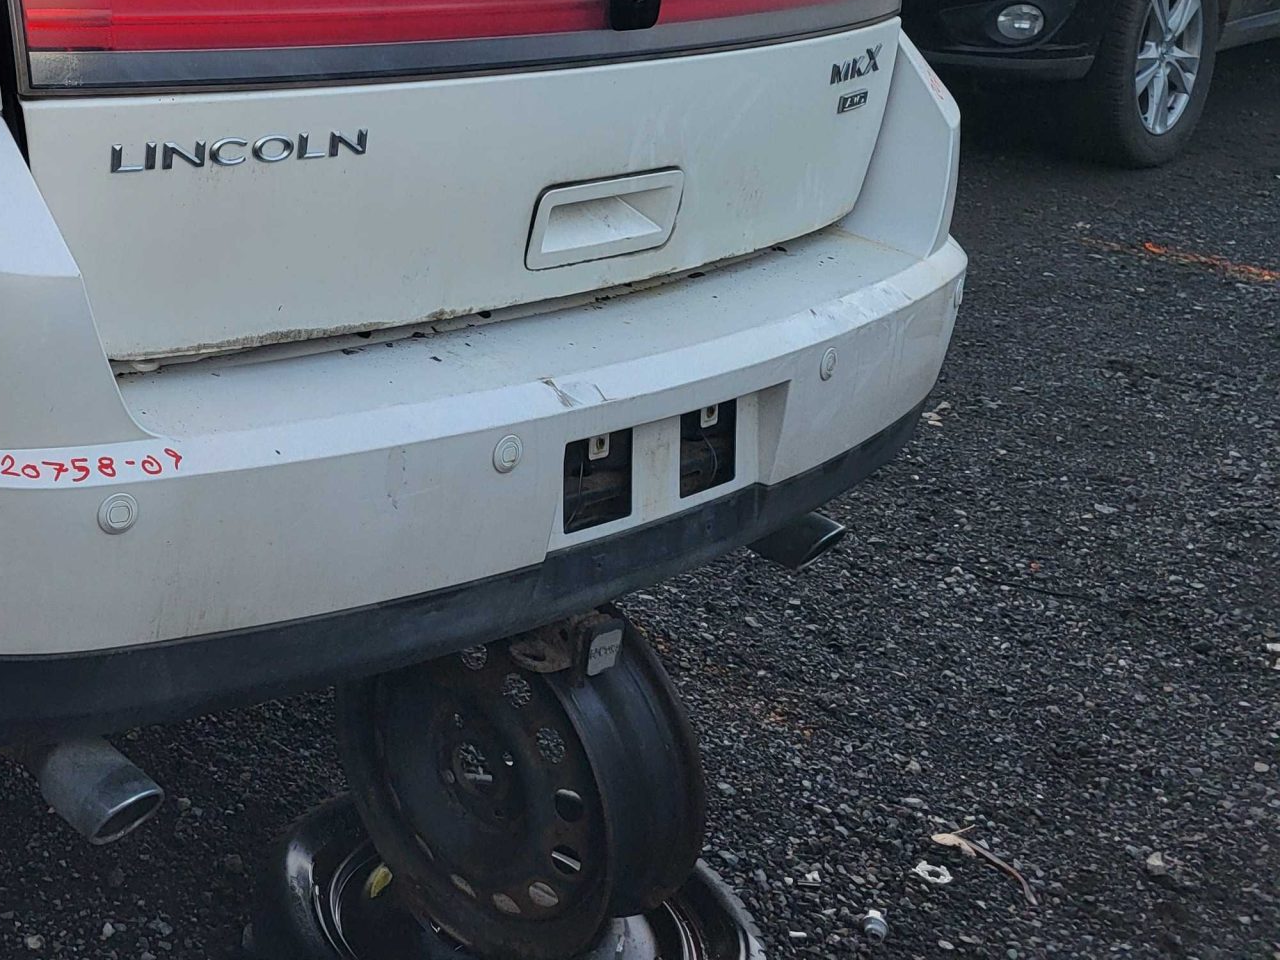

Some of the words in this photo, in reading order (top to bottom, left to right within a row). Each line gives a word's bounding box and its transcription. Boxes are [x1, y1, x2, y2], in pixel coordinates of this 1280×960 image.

[830, 43, 882, 85] MKX
[111, 128, 369, 173] LINCOLN
[0, 447, 182, 482] 20758-09
